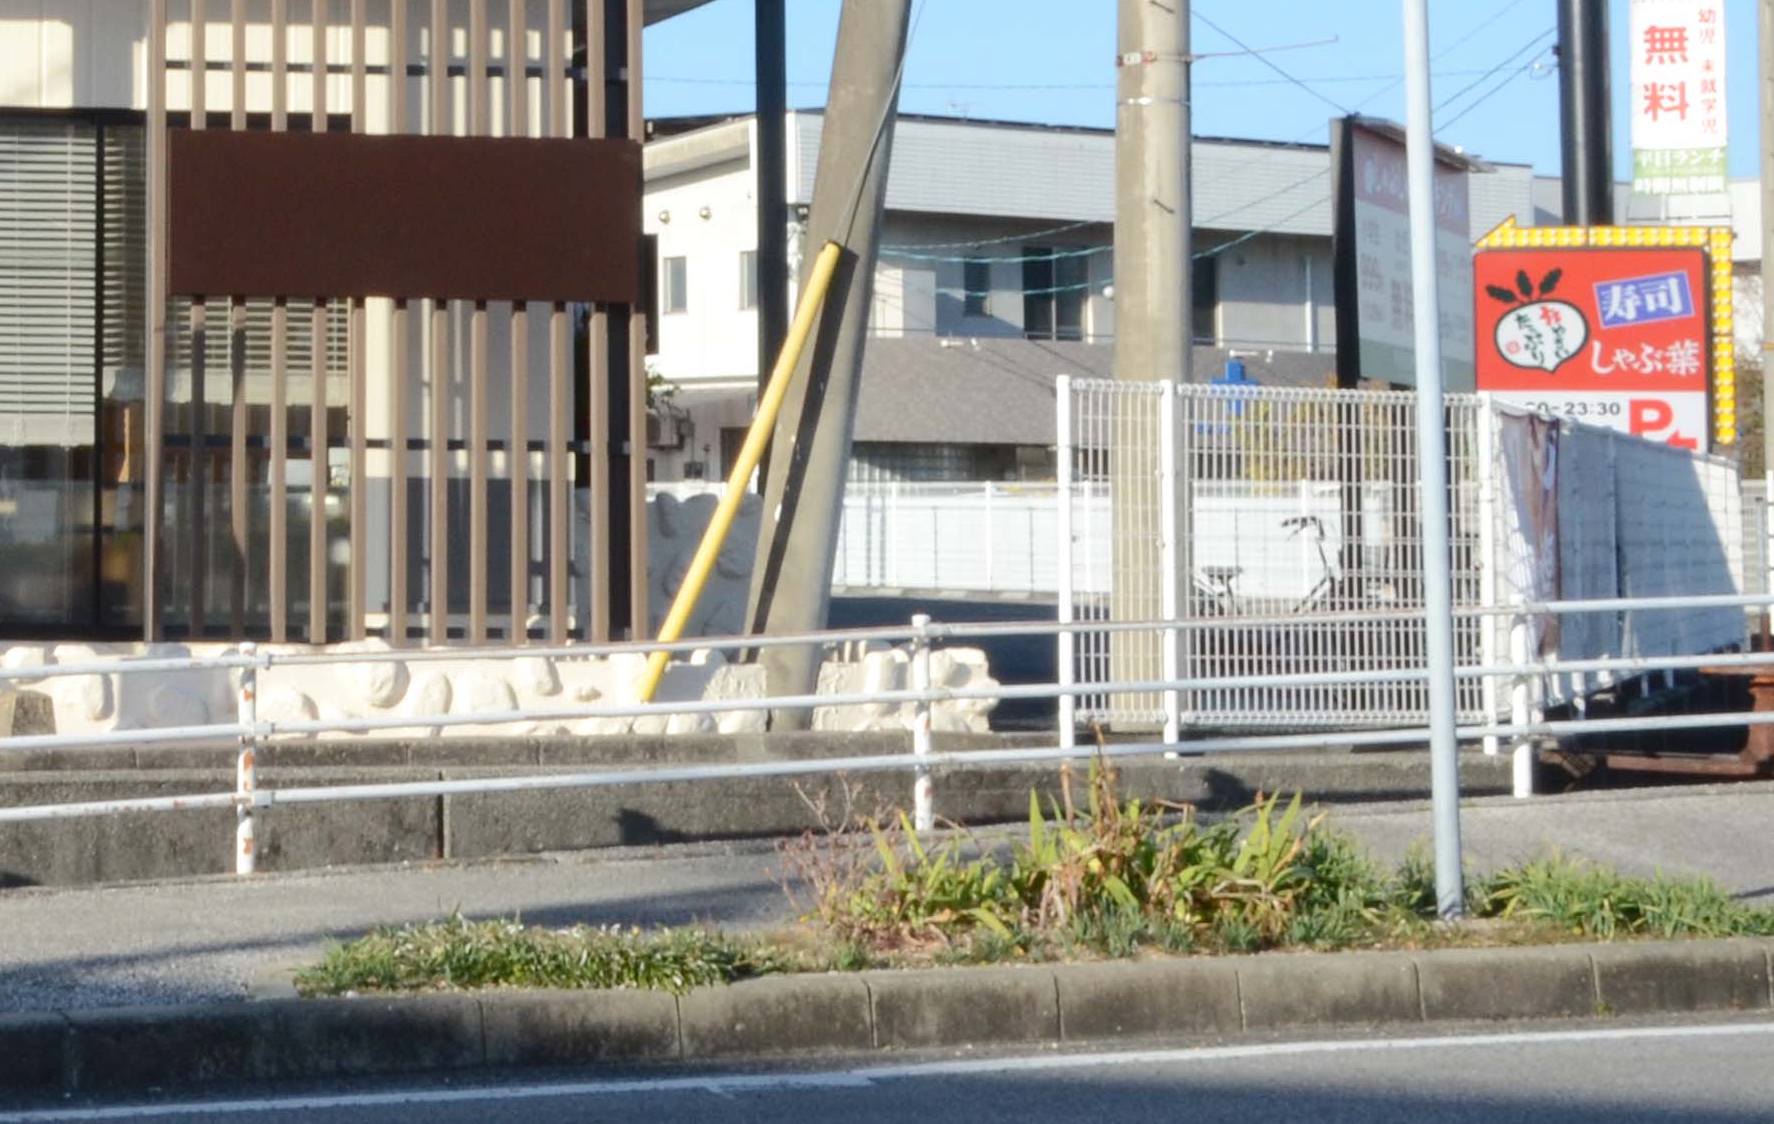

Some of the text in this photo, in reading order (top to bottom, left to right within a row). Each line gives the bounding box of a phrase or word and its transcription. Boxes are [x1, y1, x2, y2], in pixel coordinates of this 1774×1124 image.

[1643, 25, 1690, 122] 無料
[1599, 277, 1684, 321] 寿司
[1590, 340, 1701, 376] しゃぶ葉
[1629, 398, 1673, 436] P
